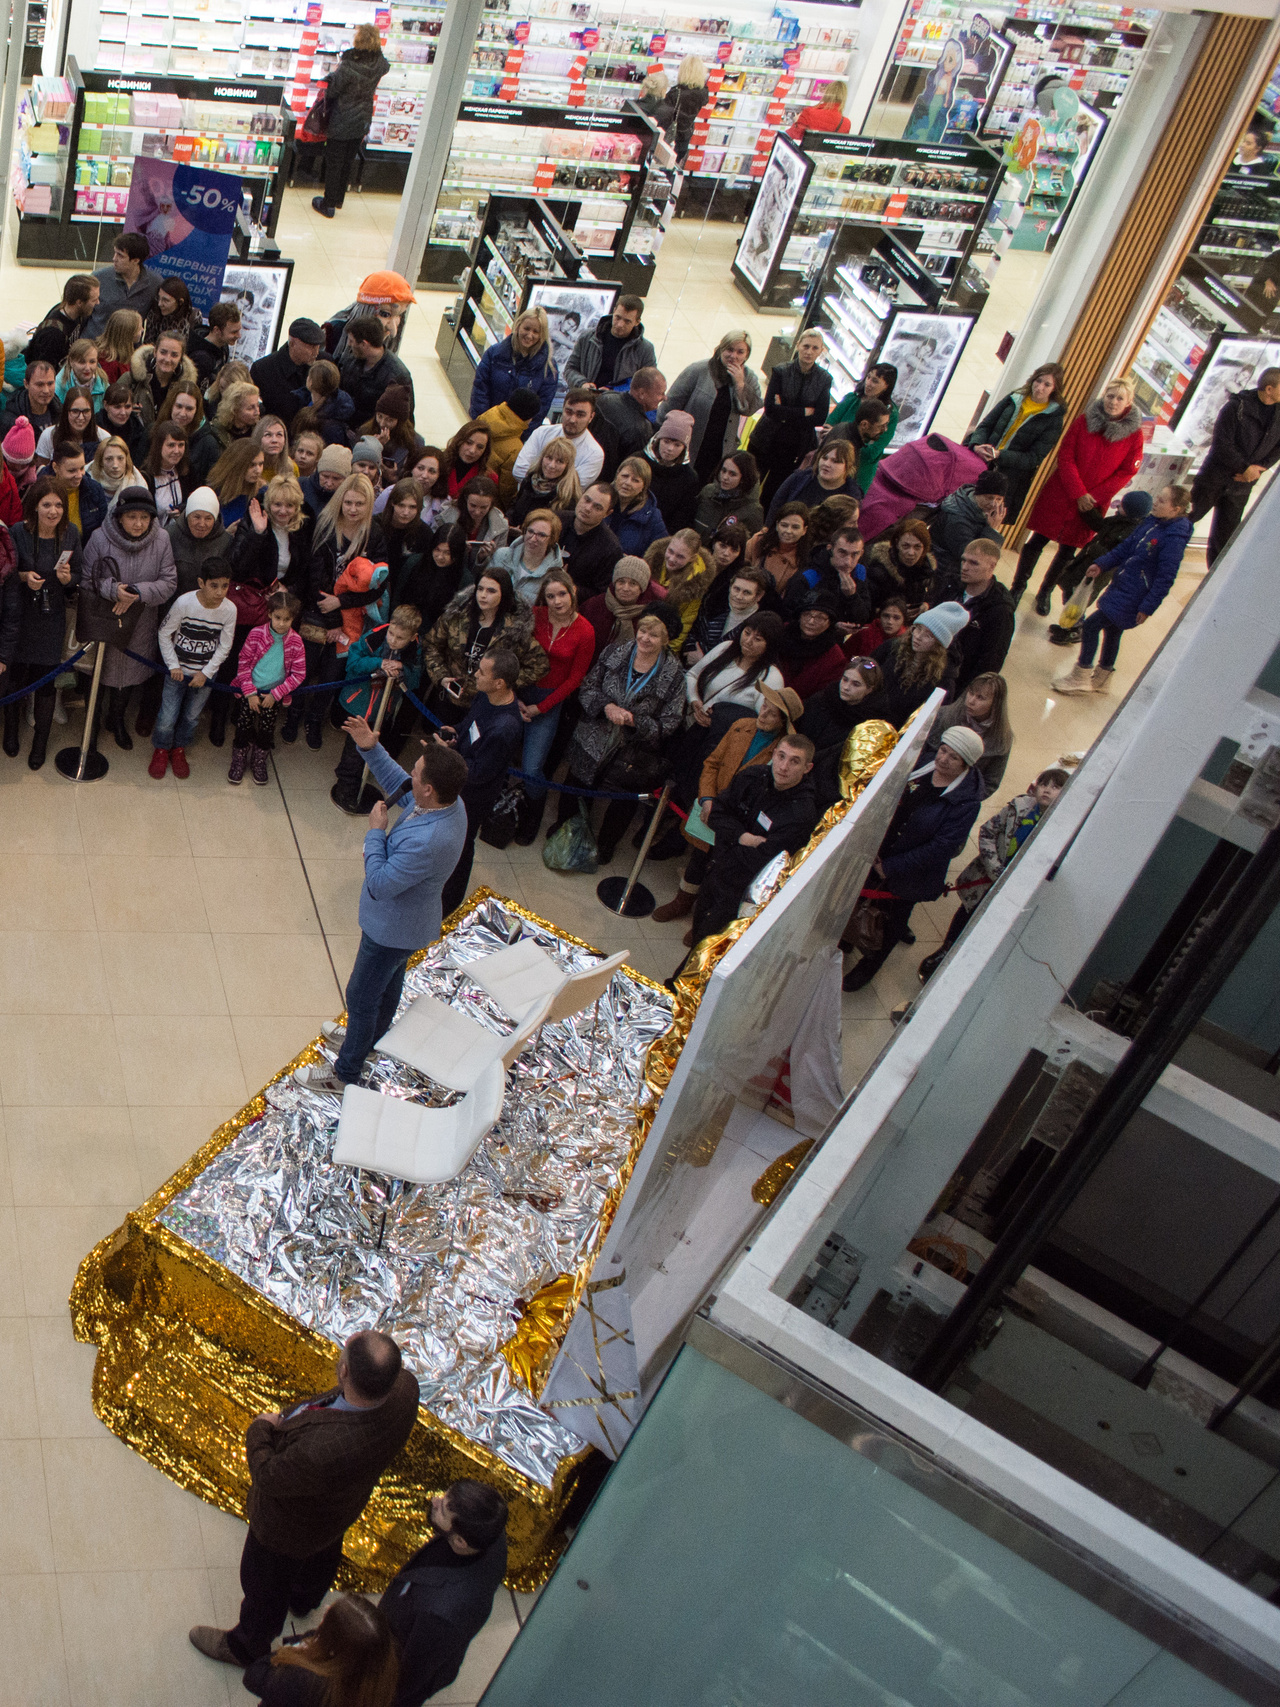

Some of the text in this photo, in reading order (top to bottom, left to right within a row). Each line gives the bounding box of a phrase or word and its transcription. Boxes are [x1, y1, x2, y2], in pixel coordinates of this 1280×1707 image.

[108, 79, 152, 91] НОВИНКИ
[214, 87, 257, 98] НОВИНКИ
[174, 143, 193, 152] АКЦИЯ
[939, 149, 968, 157] ТЕРРИТОРИЯ
[536, 170, 554, 178] АКЦИЯ
[181, 184, 236, 213] -50%
[888, 200, 905, 208] АКЦИЯ
[159, 254, 223, 276] ВПЕРВЫЕ!
[182, 270, 217, 286] САМА
[187, 283, 214, 296] БЫХ
